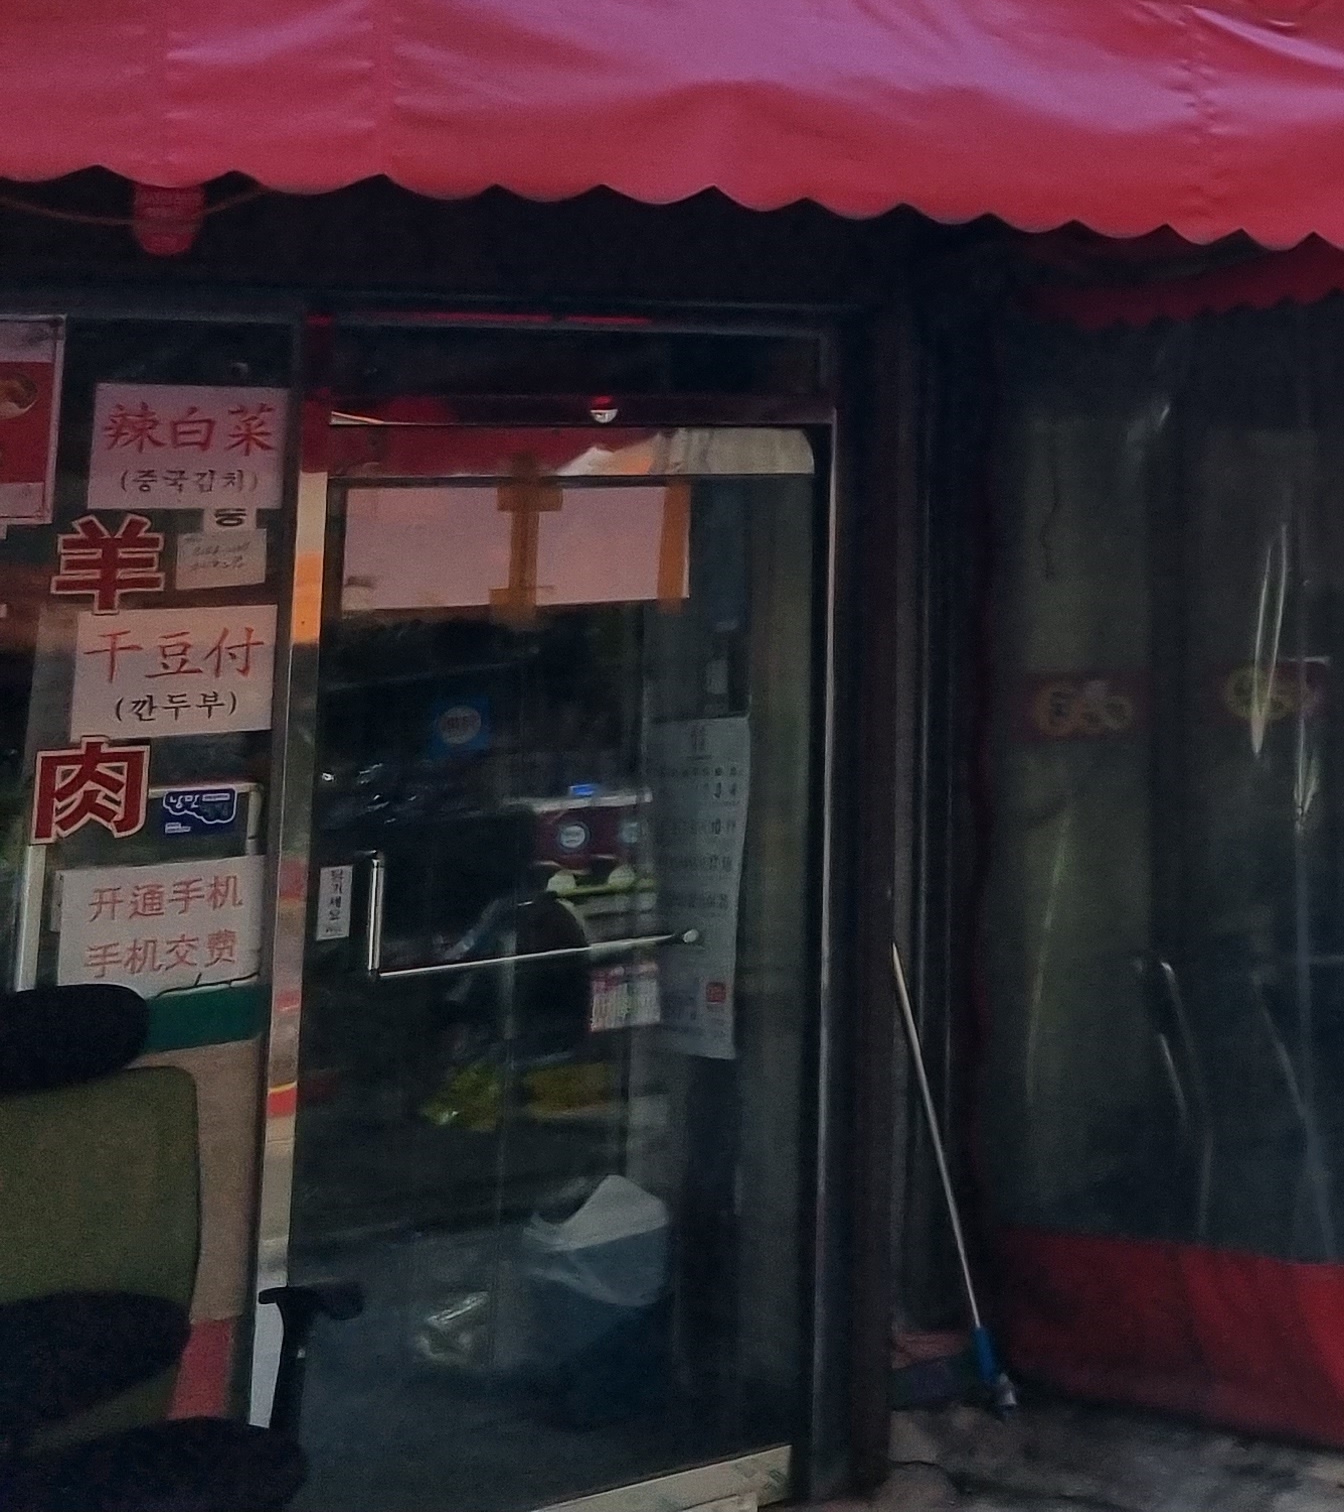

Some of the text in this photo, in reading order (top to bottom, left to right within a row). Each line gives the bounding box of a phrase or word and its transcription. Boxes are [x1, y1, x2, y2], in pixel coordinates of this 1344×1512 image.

[104, 401, 277, 457] 辣白菜
[30, 513, 166, 845] 羊 肉
[88, 874, 243, 923] 开通手机
[84, 928, 238, 979] 手机交费
